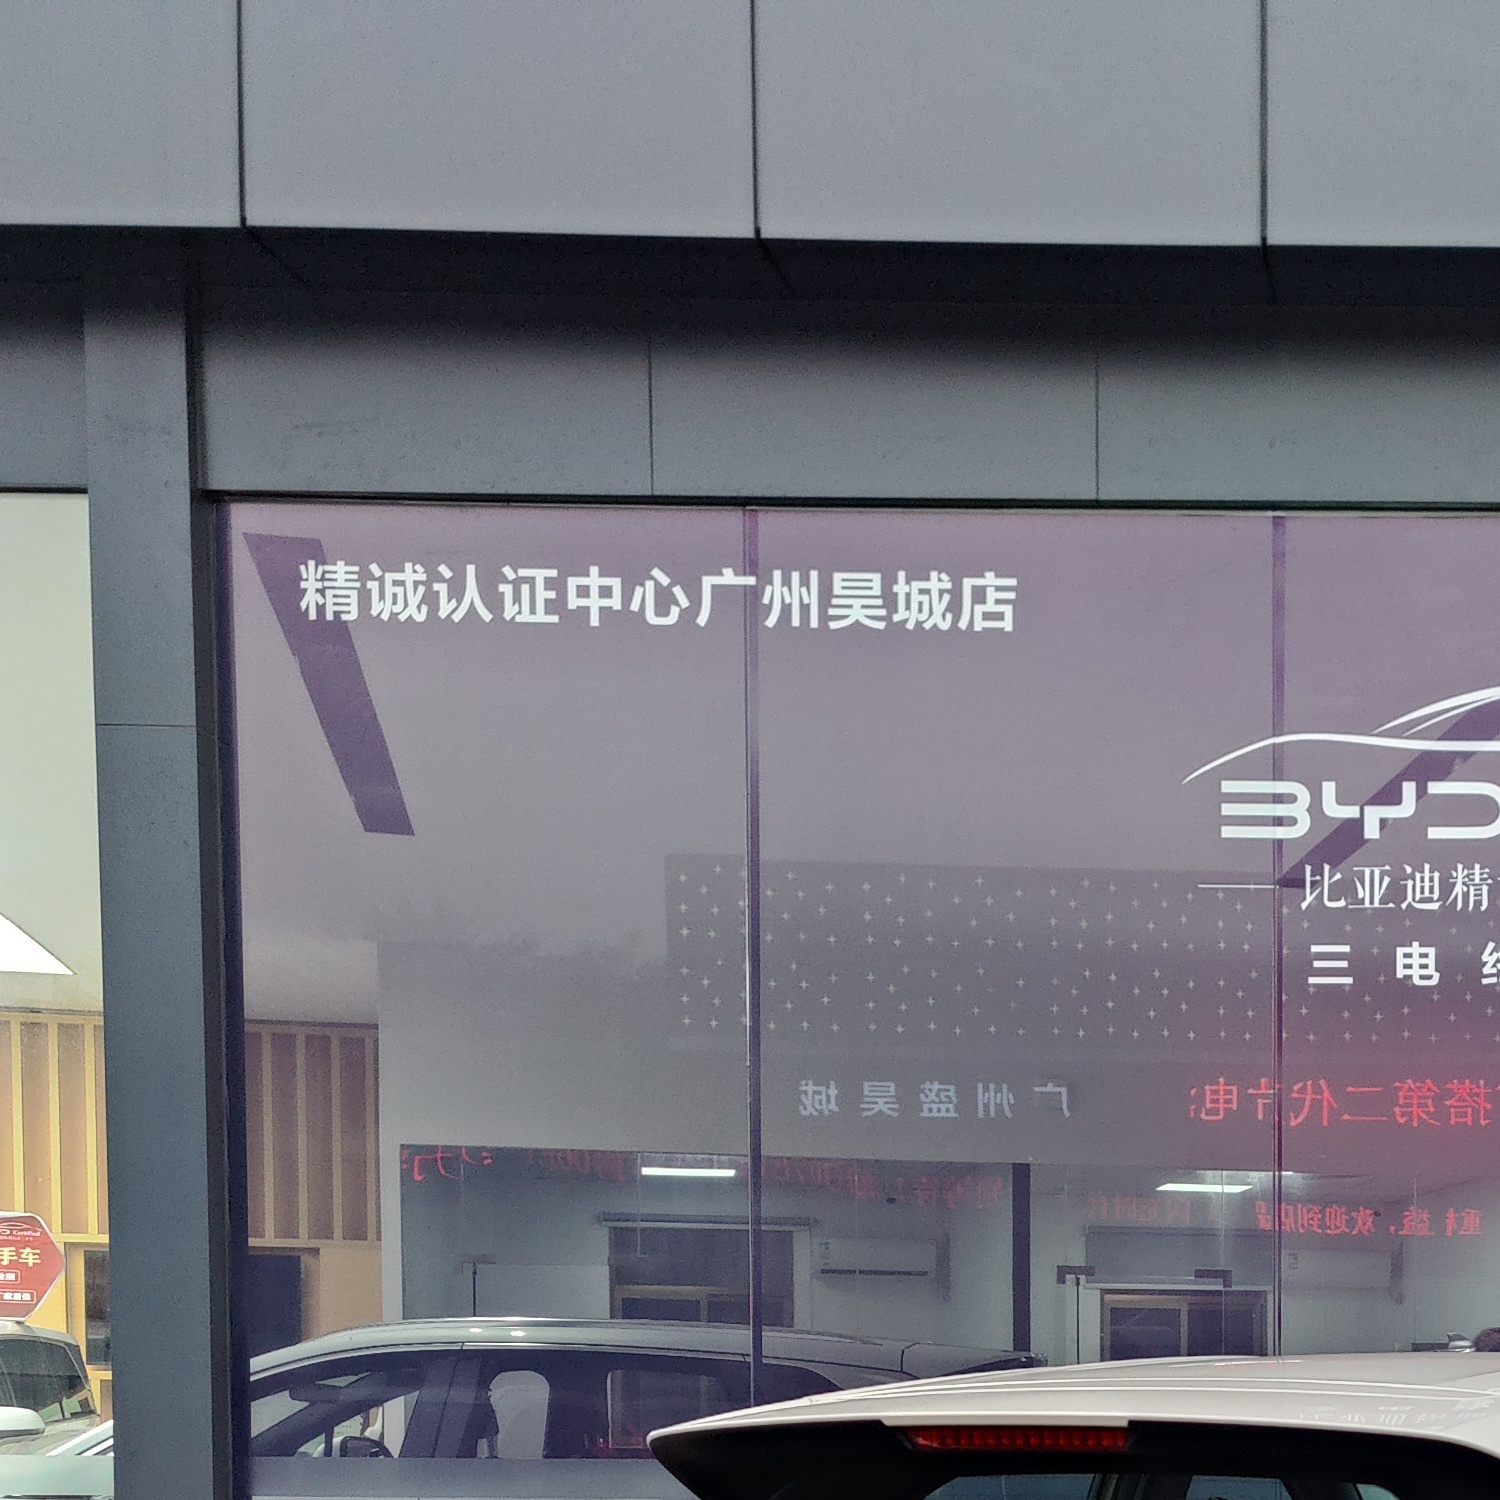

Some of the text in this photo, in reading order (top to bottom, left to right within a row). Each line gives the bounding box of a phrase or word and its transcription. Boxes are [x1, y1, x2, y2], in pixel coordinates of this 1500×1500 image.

[297, 559, 1018, 632] 精诚认证中心广州昊城店
